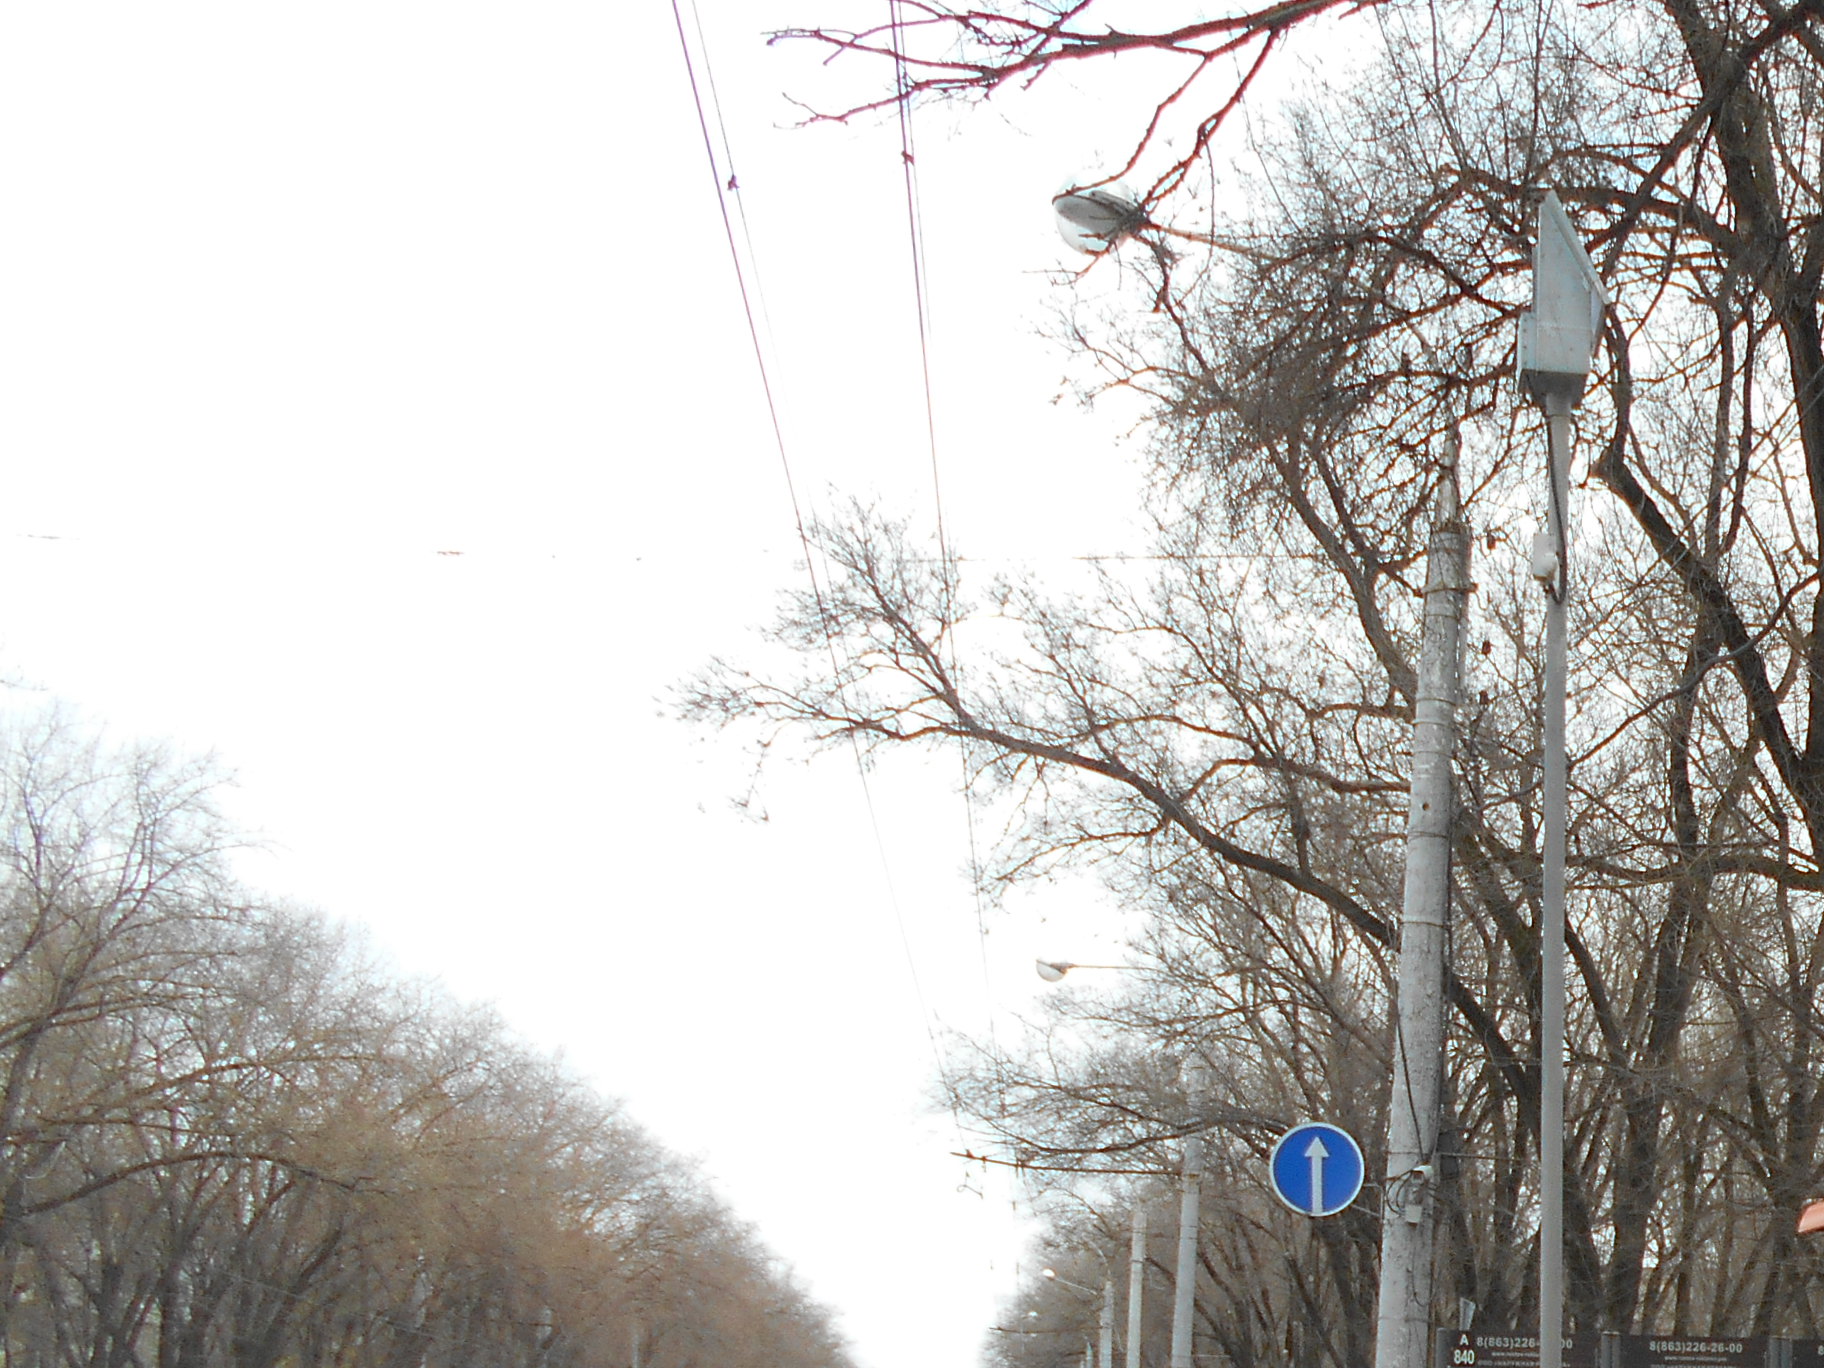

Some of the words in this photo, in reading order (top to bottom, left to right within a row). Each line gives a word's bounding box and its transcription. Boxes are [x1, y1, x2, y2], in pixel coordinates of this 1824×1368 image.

[1476, 1336, 1573, 1349] 8(863)226-00
[1649, 1341, 1743, 1354] 8(863)226-26-00
[1453, 1350, 1475, 1364] 840
